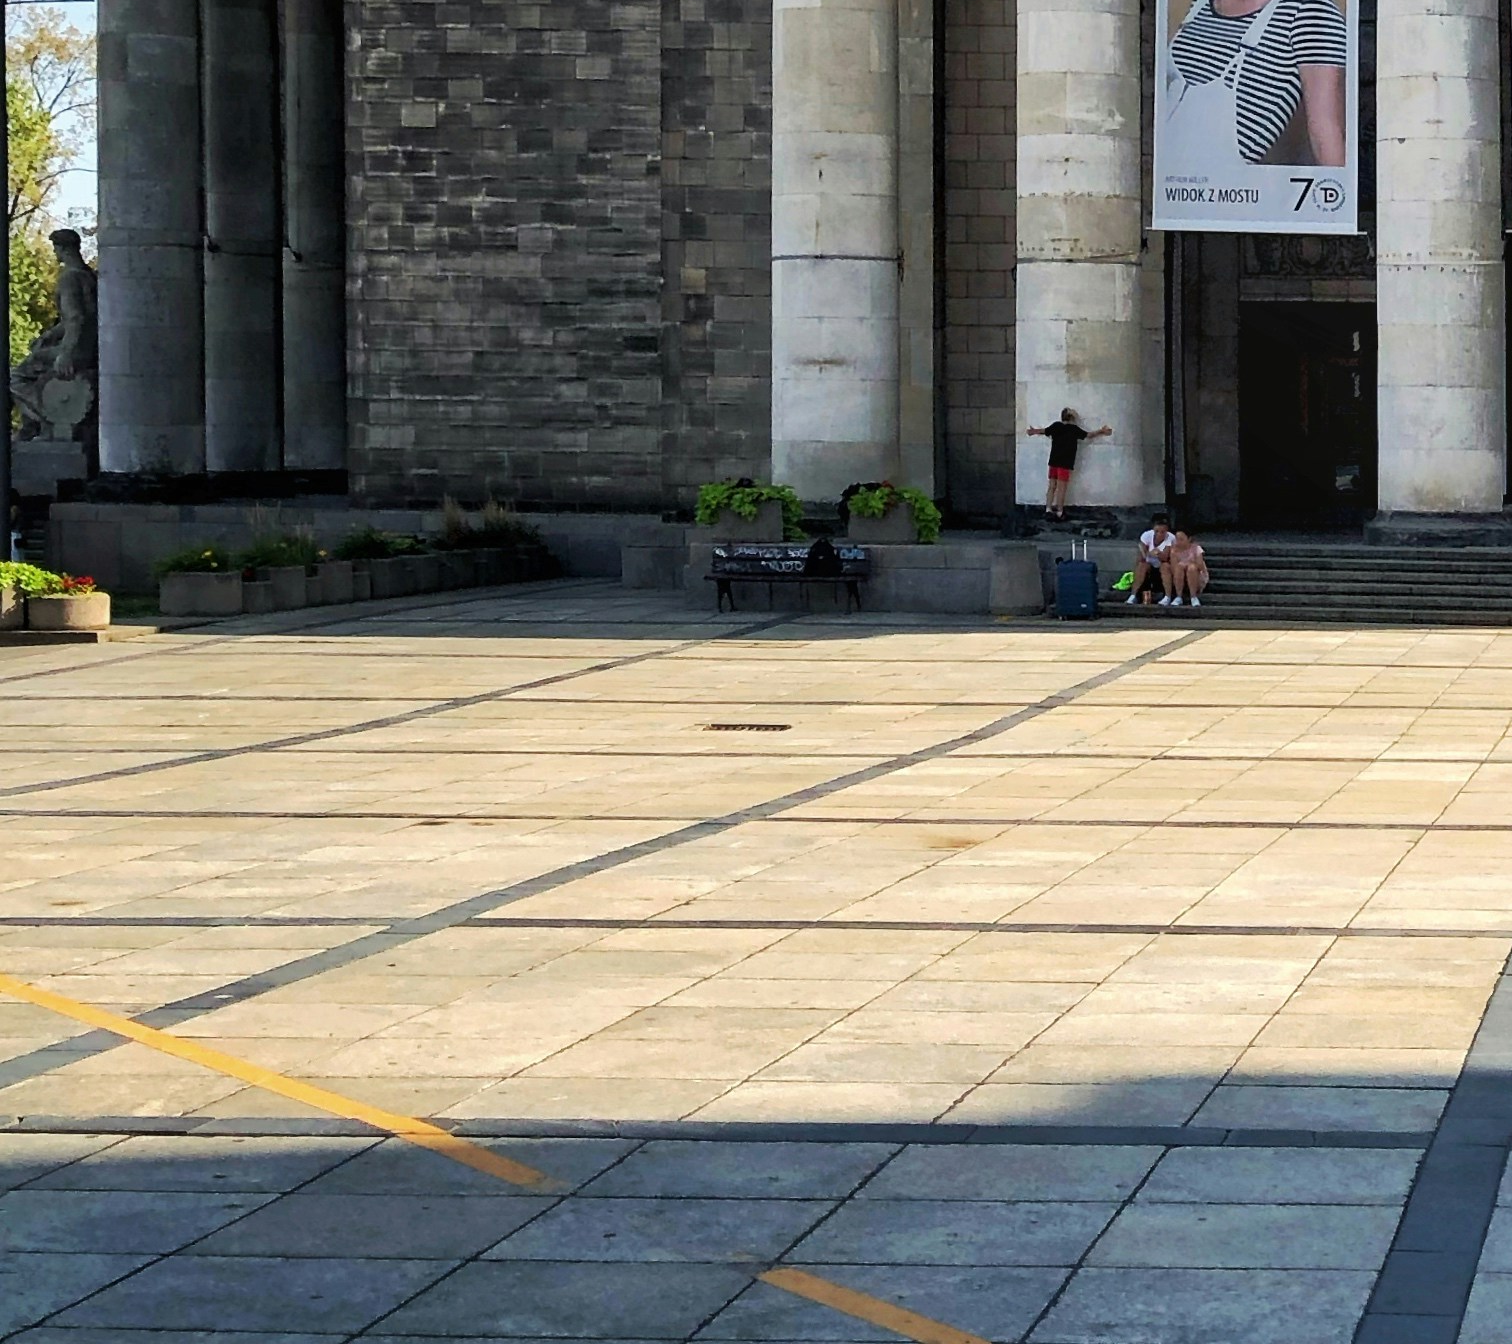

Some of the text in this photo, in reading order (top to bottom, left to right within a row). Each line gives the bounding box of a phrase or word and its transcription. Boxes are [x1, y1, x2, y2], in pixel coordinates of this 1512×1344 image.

[1165, 188, 1259, 203] WIDOK Z MOSTU
